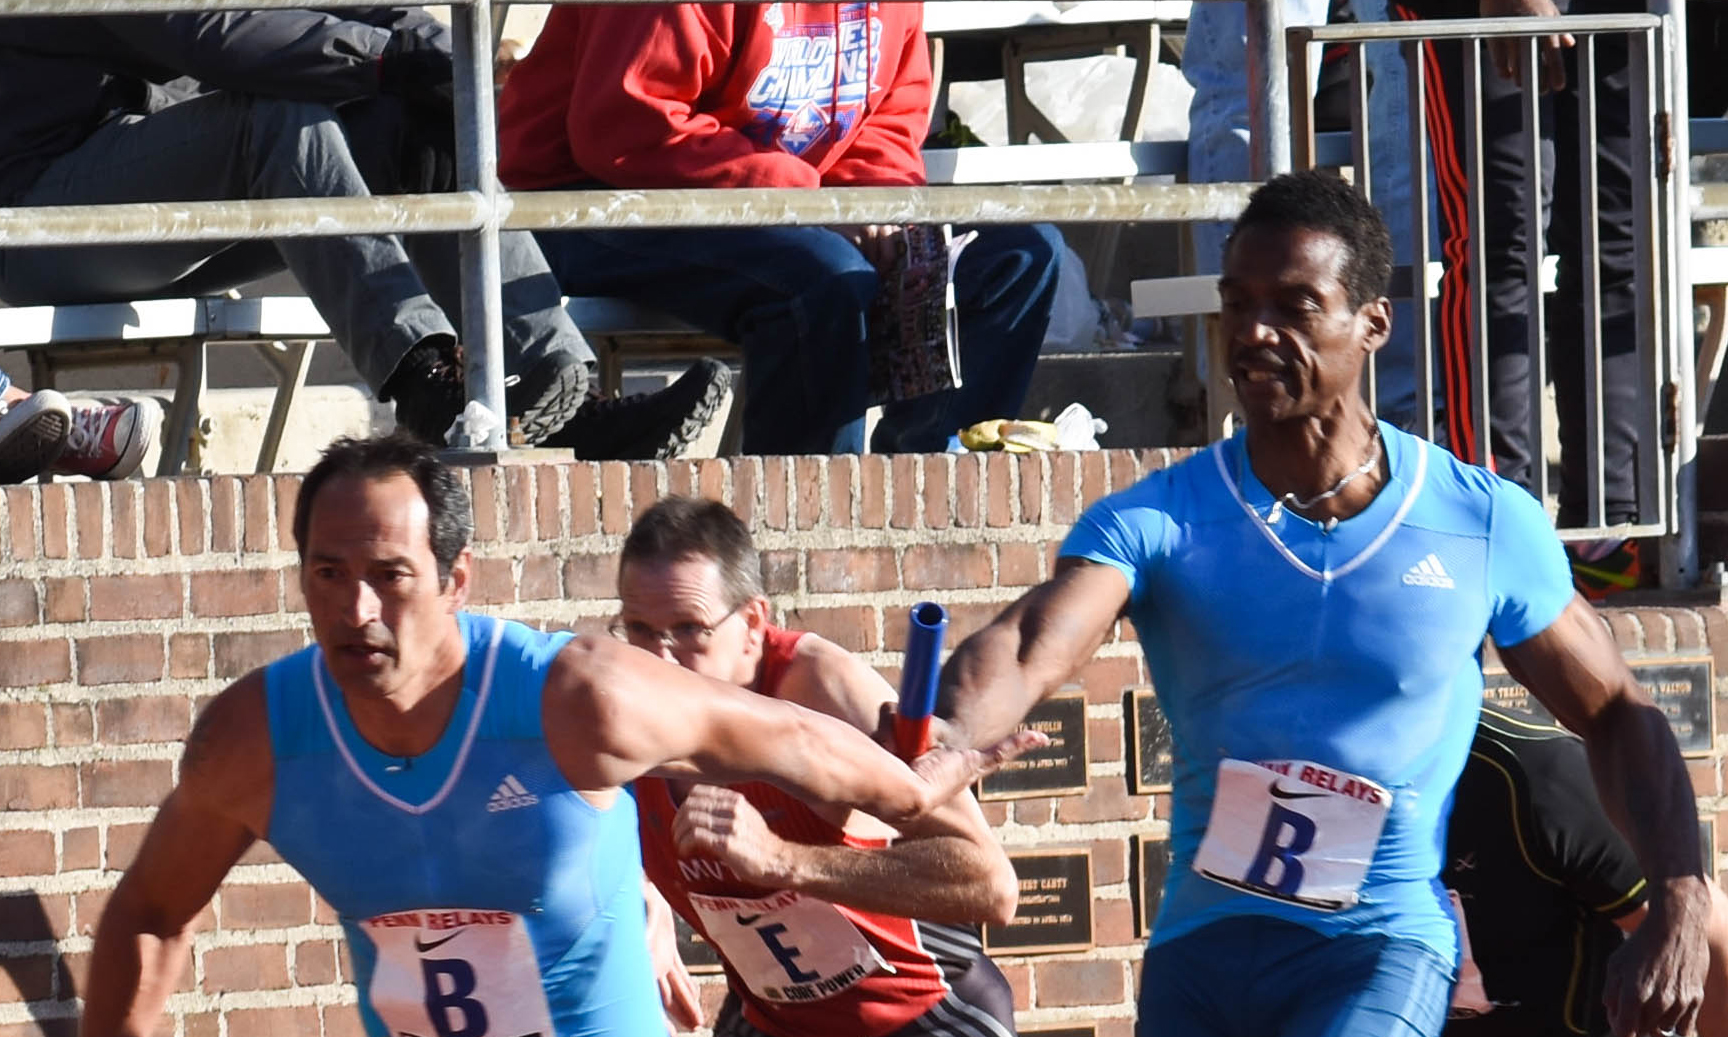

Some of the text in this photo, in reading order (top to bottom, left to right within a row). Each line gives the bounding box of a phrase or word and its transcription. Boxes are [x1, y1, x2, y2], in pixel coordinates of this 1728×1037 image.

[1299, 764, 1384, 804] RELAYS
[1244, 800, 1316, 896] B
[426, 911, 513, 931] RELAYS
[756, 922, 821, 984] E
[782, 964, 867, 1000] CORE POWER
